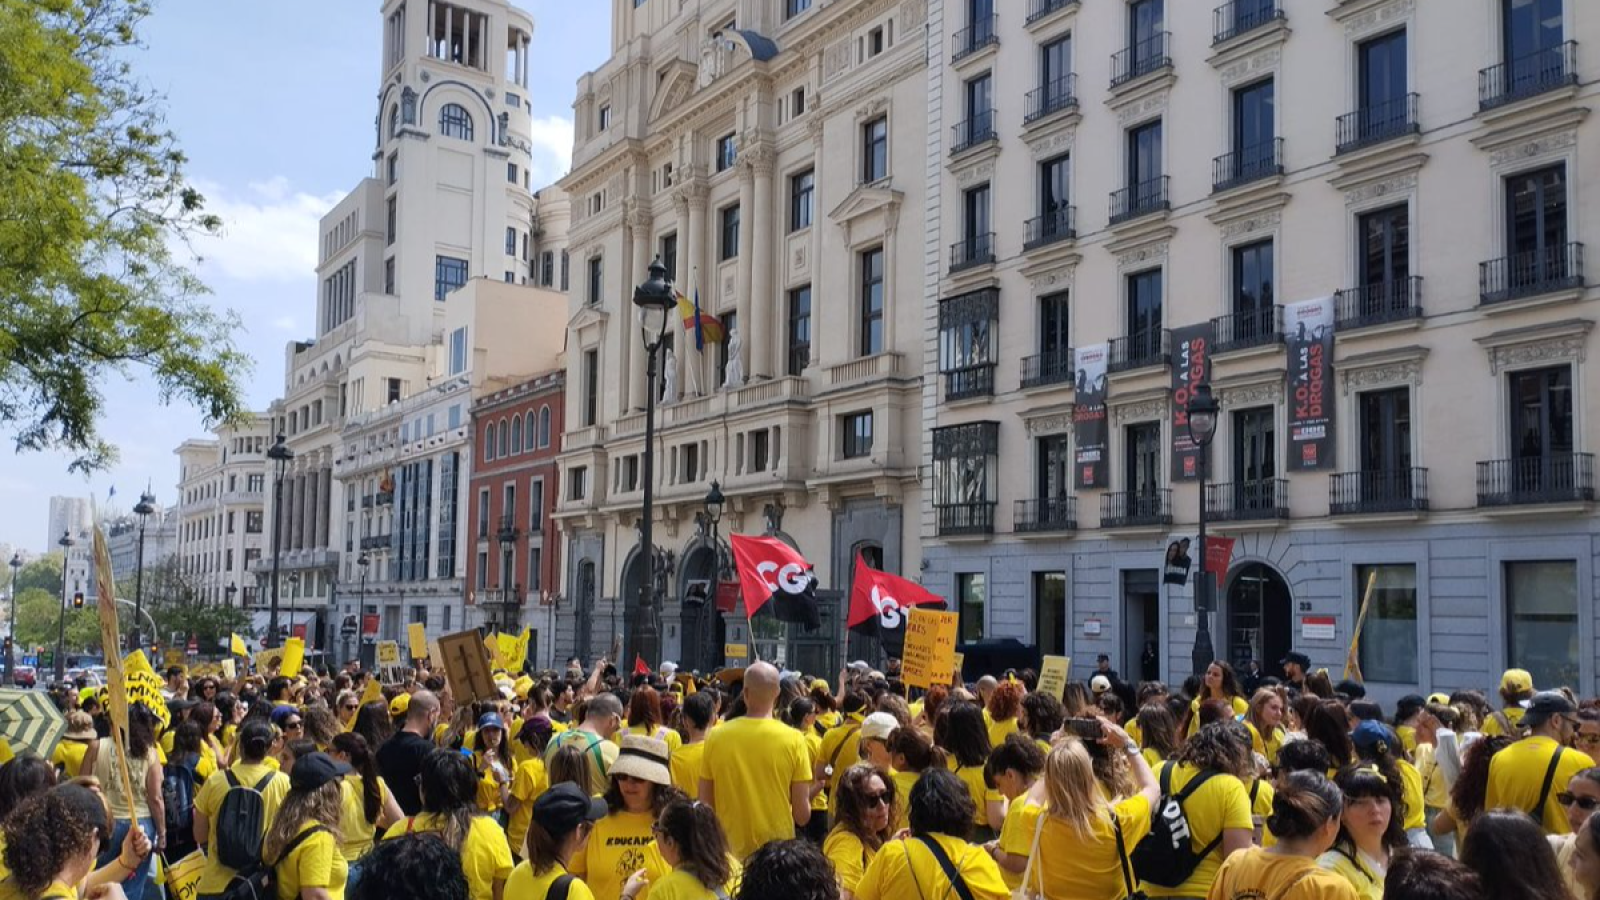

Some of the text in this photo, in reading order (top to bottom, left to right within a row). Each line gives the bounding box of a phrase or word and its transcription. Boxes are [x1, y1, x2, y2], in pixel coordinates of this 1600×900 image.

[1180, 341, 1189, 368] LAS
[1300, 347, 1308, 369] LAS
[1300, 372, 1308, 381] A
[1309, 343, 1323, 418] DROGAS
